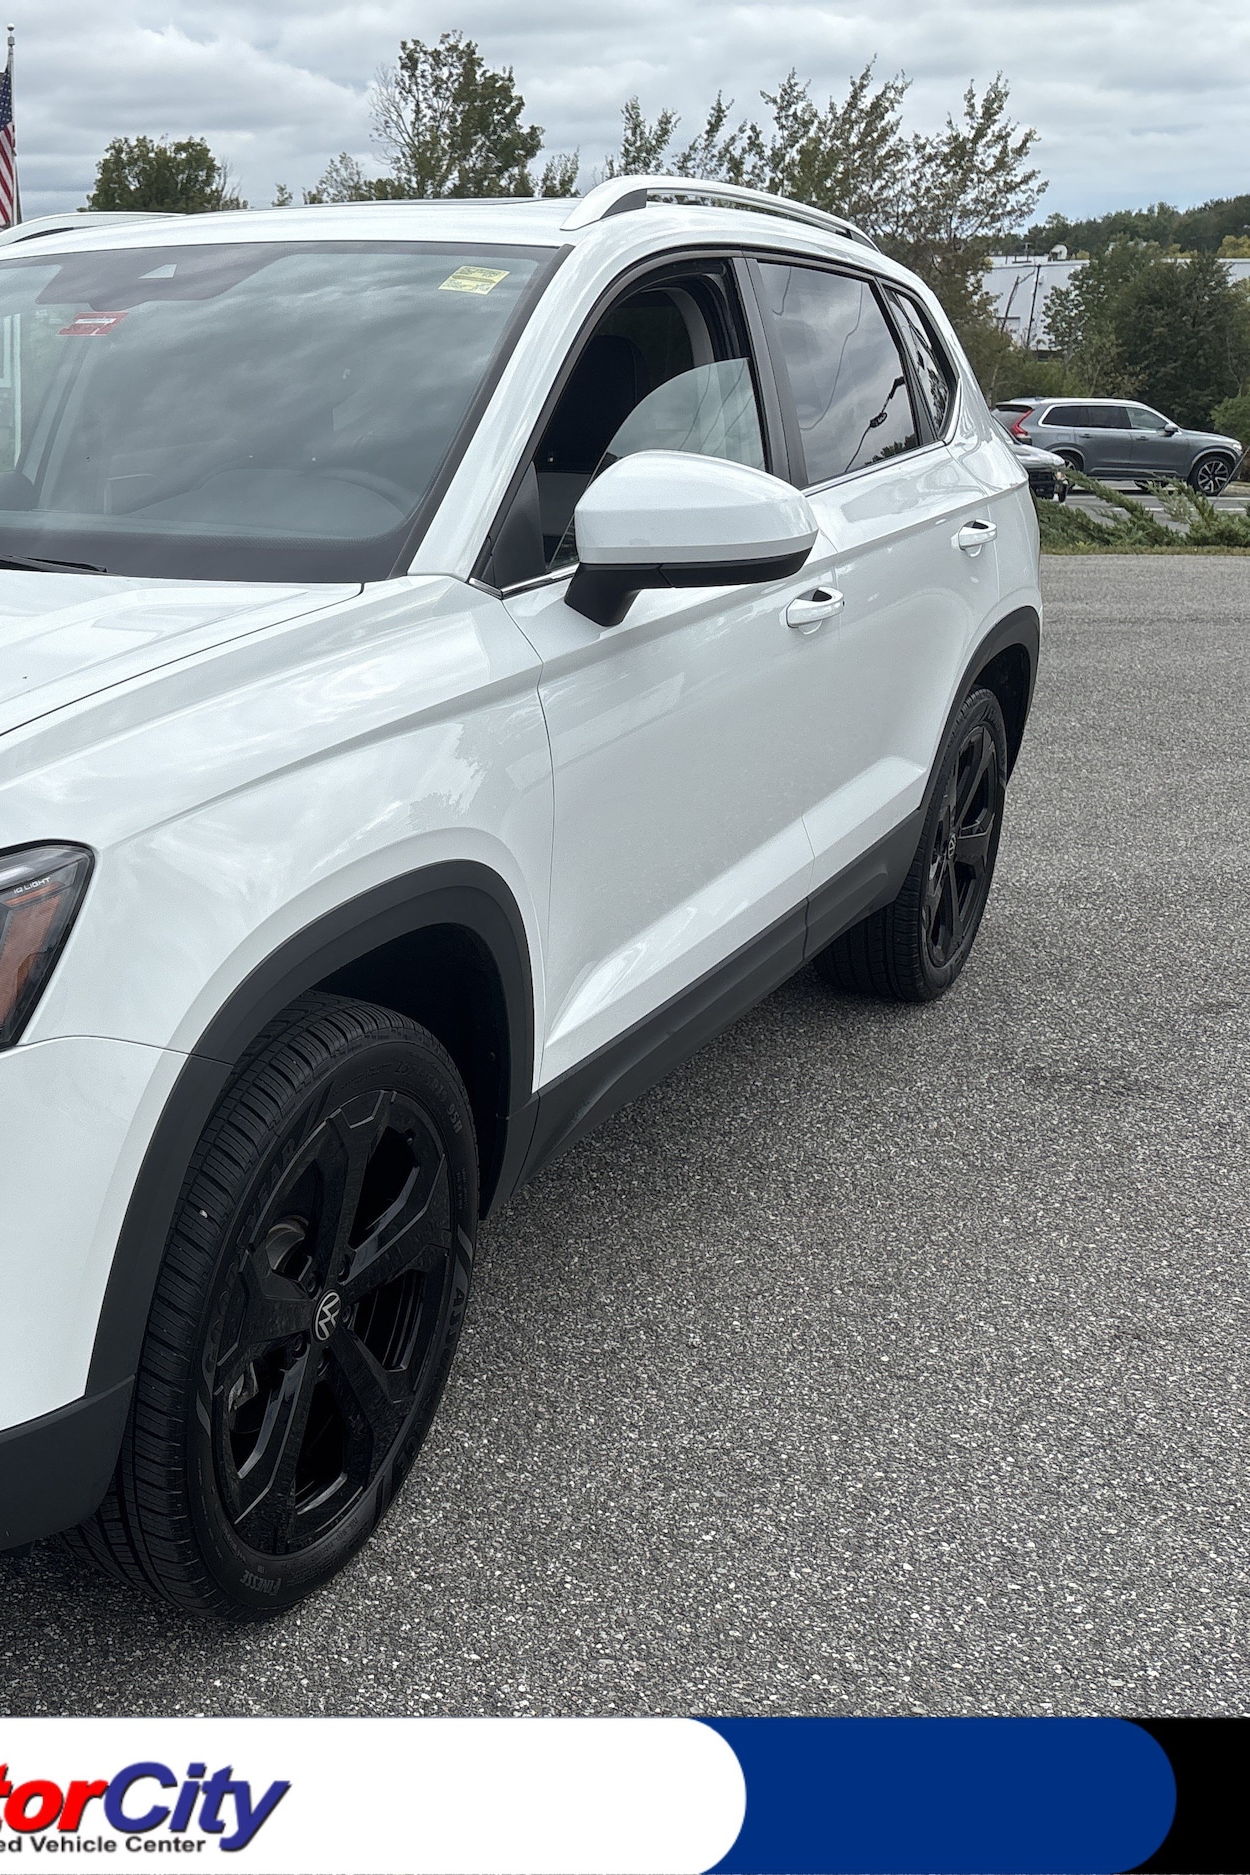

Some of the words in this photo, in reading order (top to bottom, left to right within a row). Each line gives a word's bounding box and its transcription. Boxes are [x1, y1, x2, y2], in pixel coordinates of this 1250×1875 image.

[13, 876, 51, 894] IQ.LIGHT
[446, 1103, 463, 1134] 95H
[239, 1569, 282, 1597] FINESSE
